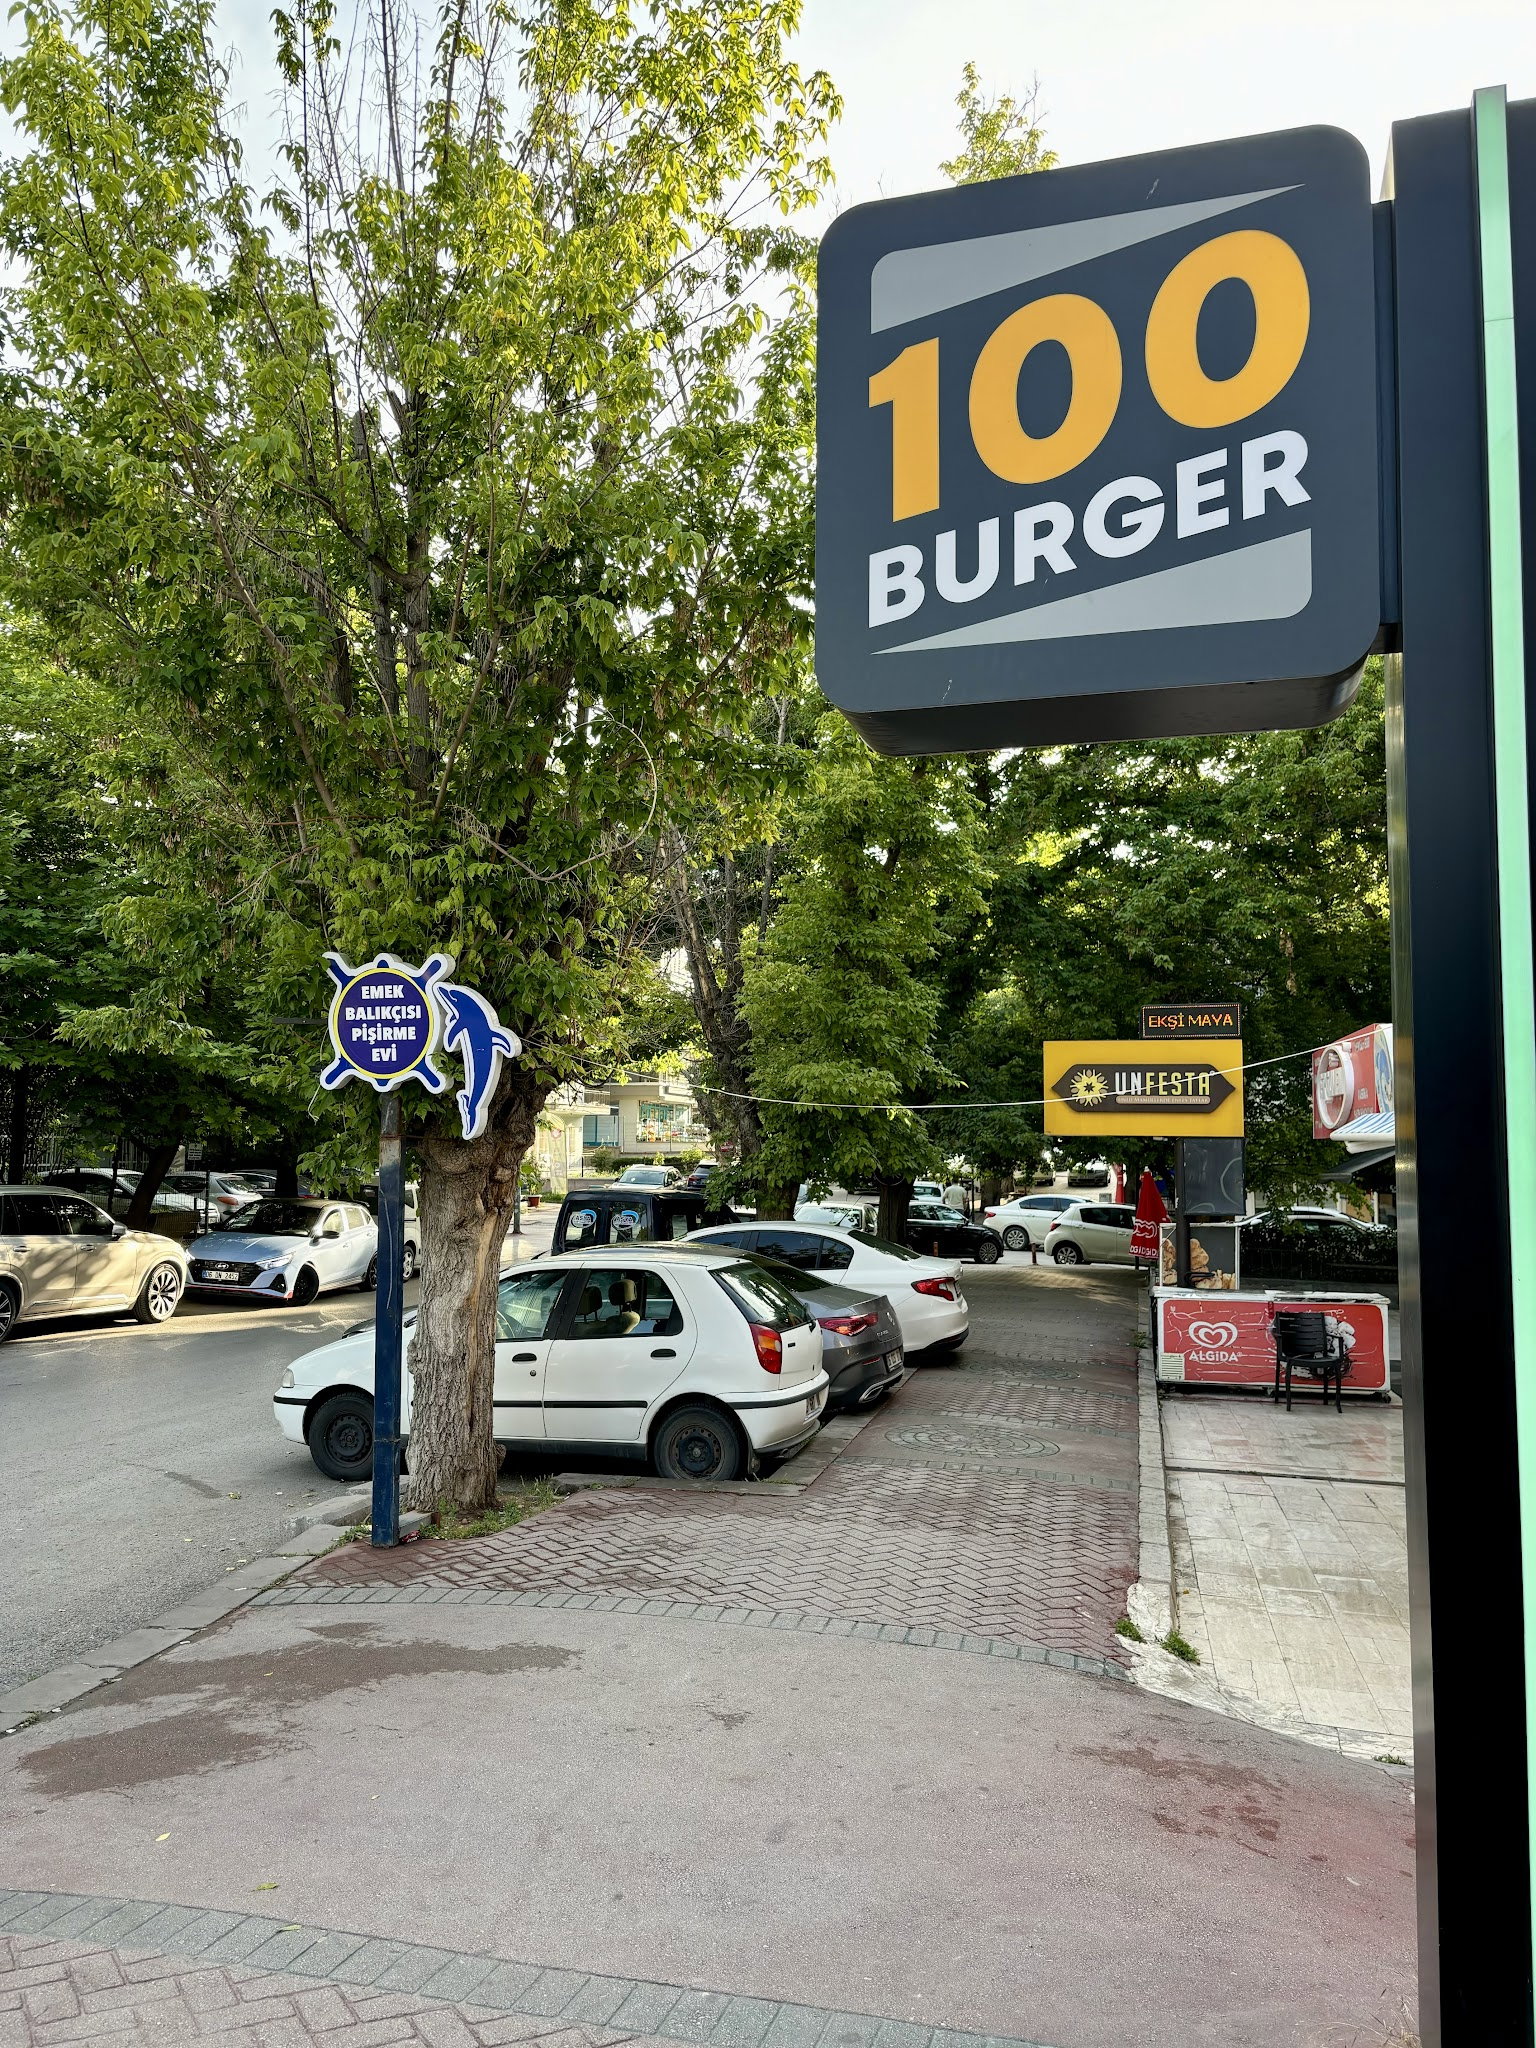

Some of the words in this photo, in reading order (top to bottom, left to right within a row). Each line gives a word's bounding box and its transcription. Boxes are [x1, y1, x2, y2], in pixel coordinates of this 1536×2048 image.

[868, 229, 1311, 523] 100
[868, 430, 1312, 628] BURGER
[361, 985, 405, 1000] EMEK
[345, 1005, 421, 1023] BALIKÇISI
[1148, 1012, 1185, 1030] EKŞİ
[1189, 1013, 1233, 1027] MAYA
[352, 1023, 416, 1045] PİŞİRME
[371, 1043, 397, 1062] EVİ
[1114, 1072, 1210, 1096] UNFESTA
